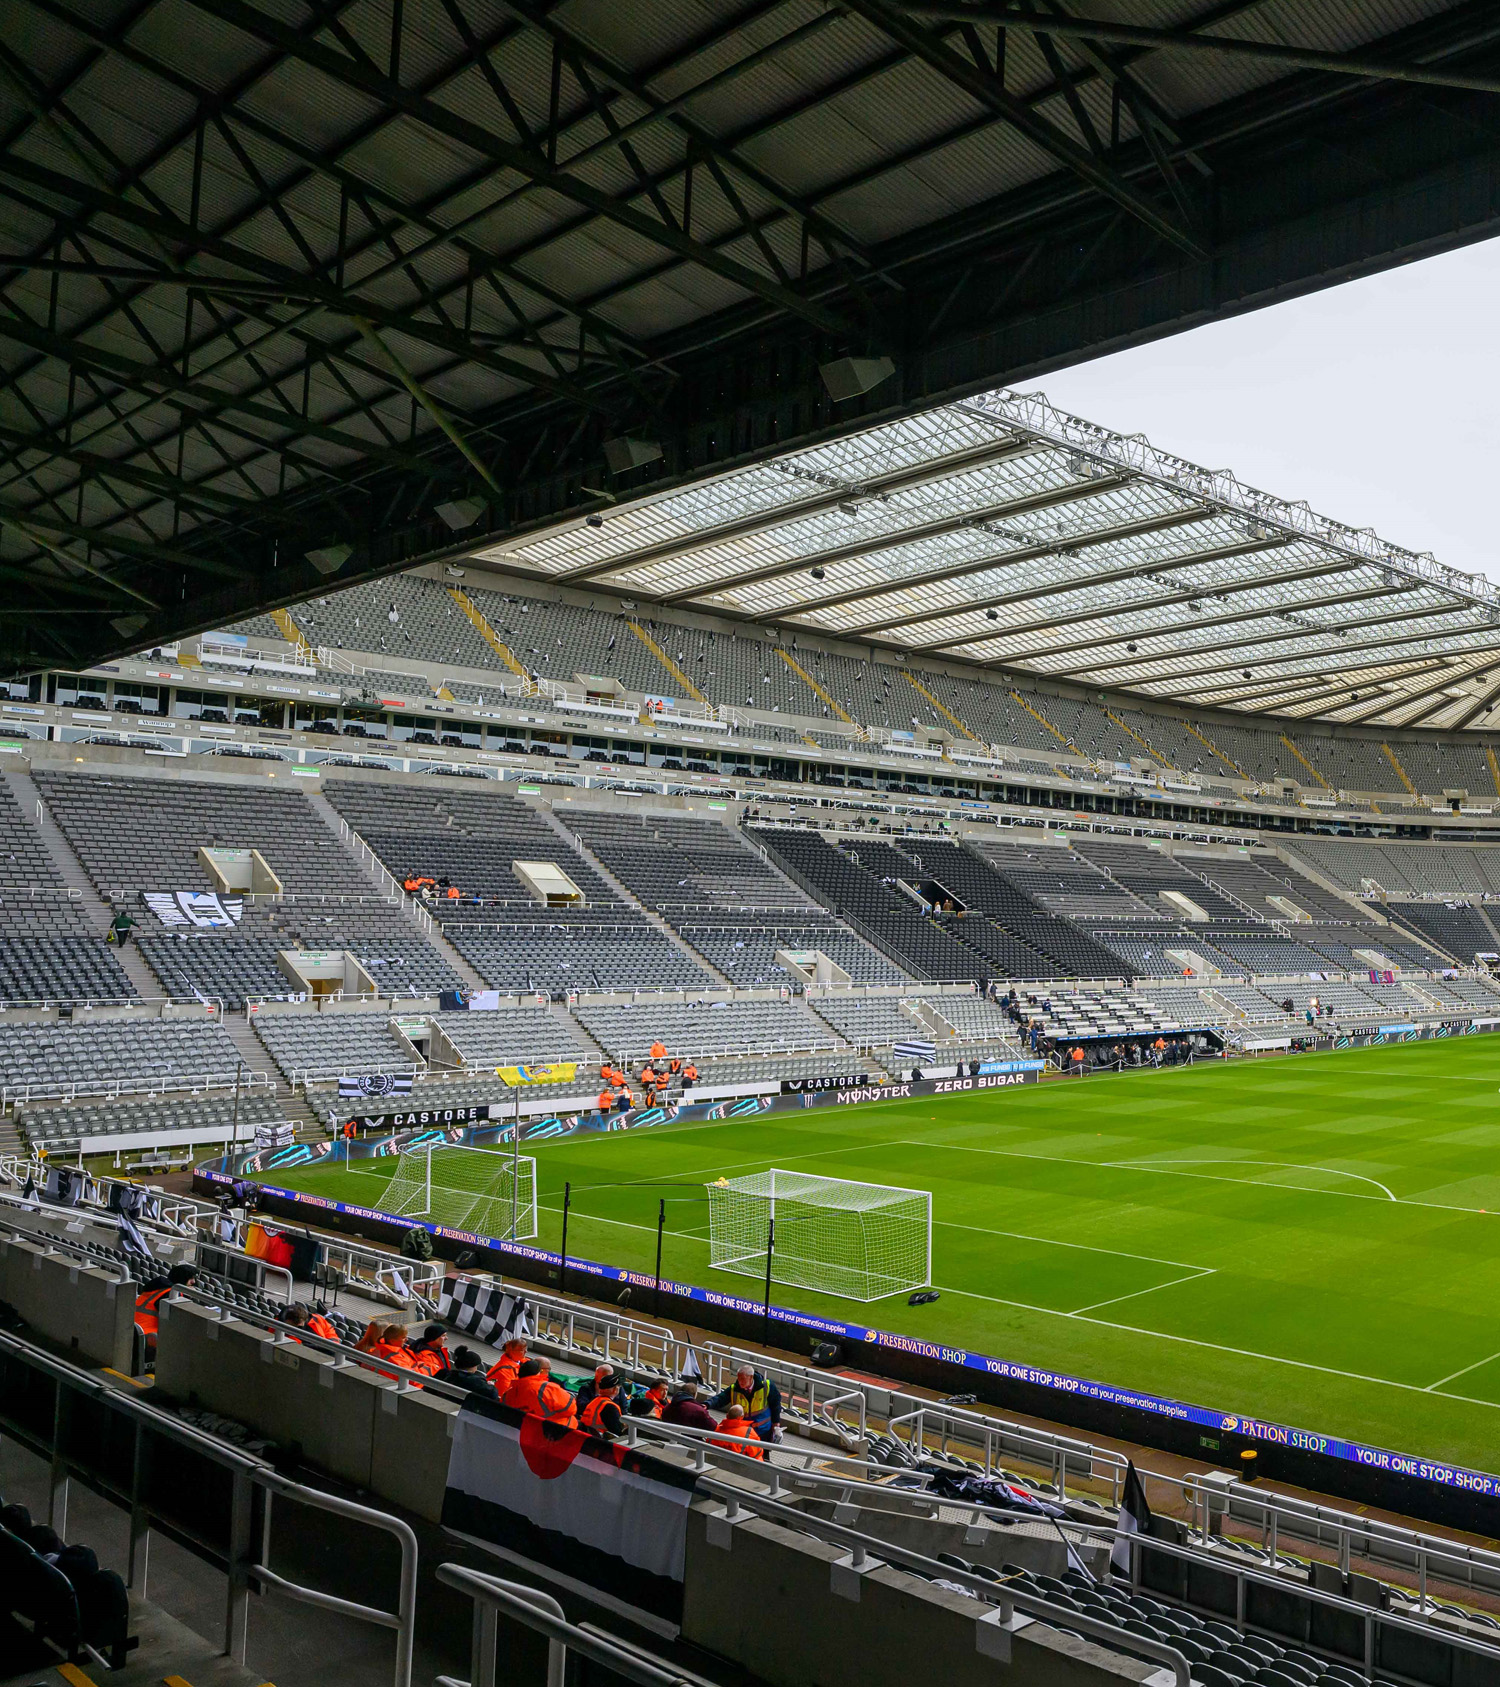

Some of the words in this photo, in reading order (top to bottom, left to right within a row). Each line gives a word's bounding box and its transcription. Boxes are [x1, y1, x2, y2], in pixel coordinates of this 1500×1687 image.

[1355, 1027, 1379, 1036] CASTORE
[807, 1075, 861, 1089] CASTORE
[935, 1079, 972, 1093] ZERO
[978, 1073, 1025, 1088] SUGAR
[394, 1108, 477, 1126] CASTORE
[327, 1200, 338, 1210] SHOP
[345, 1205, 355, 1214] YOUR
[362, 1209, 373, 1218] STOP
[373, 1211, 383, 1220] SHOP
[443, 1228, 476, 1245] PRESERVATION
[477, 1235, 491, 1247] SHOP
[501, 1243, 513, 1252] YOUR
[513, 1245, 523, 1254] ONE
[523, 1247, 535, 1258] STOP
[535, 1250, 548, 1261] SHOP
[588, 1264, 603, 1275] supplies
[674, 1285, 692, 1297] SHOP
[706, 1292, 722, 1305] YOUR
[723, 1296, 735, 1308] ONE
[736, 1299, 752, 1312] STOP
[784, 1313, 795, 1323] your
[796, 1316, 825, 1330] preservation
[825, 1323, 847, 1335] supplies
[879, 1333, 940, 1359] PRESERVATION
[942, 1349, 967, 1365] SHOP
[986, 1360, 1009, 1376] YOUR
[1010, 1366, 1028, 1380] ONE
[1029, 1370, 1052, 1386] STOP
[1054, 1376, 1079, 1392] SHOP
[1080, 1383, 1089, 1392] for
[1090, 1386, 1098, 1396] all
[1099, 1390, 1114, 1401] your
[1115, 1392, 1157, 1410] preservation
[1158, 1402, 1188, 1418] supplies
[1242, 1420, 1288, 1444] PATION
[1292, 1432, 1327, 1453] SHOP
[1356, 1448, 1389, 1469] YOUR
[1391, 1457, 1418, 1476] ONE
[1420, 1463, 1453, 1483] STOP
[1455, 1472, 1492, 1493] SHOP
